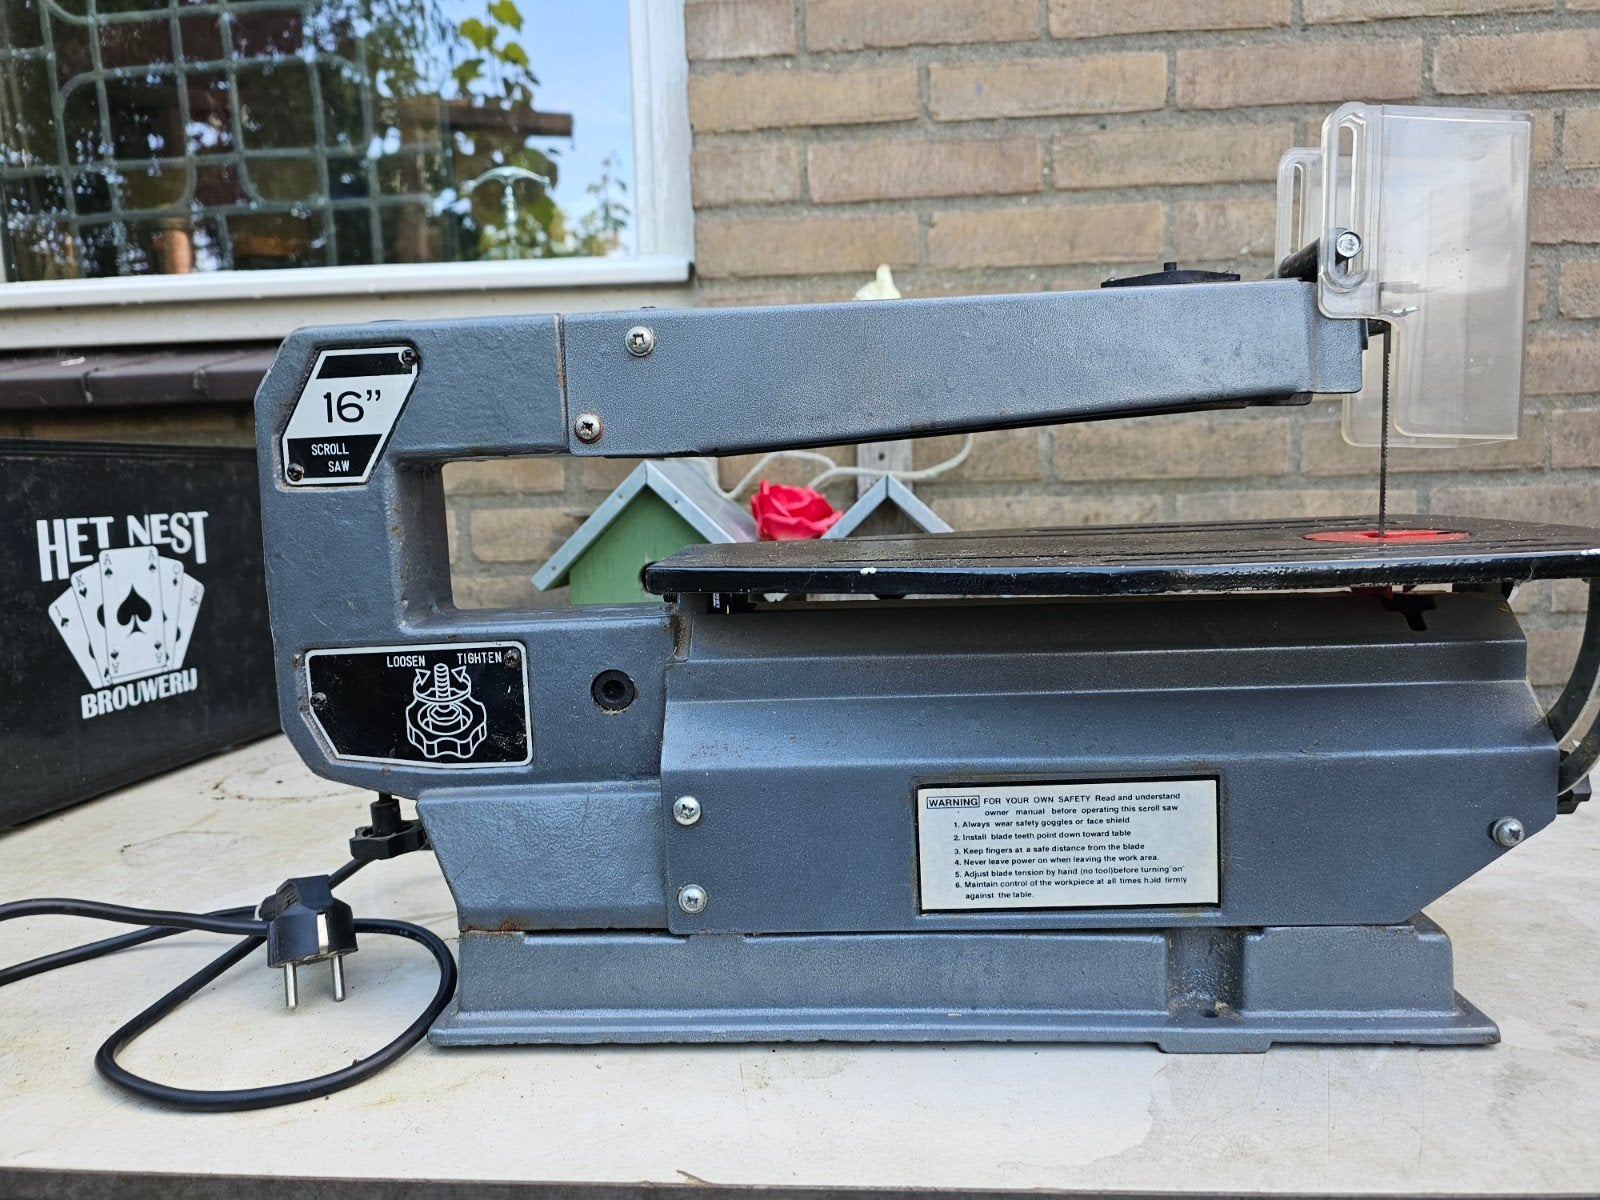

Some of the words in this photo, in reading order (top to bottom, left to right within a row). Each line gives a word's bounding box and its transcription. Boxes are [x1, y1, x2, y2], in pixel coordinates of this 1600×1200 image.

[311, 443, 350, 456] SCROLL
[328, 460, 350, 473] SAW
[36, 516, 115, 582] HET
[126, 511, 209, 564] NEST
[386, 655, 426, 668] LOOSEN
[456, 651, 503, 665] TIGHTEN
[928, 797, 978, 807] WARNING
[983, 797, 1001, 805] FOR
[1005, 796, 1029, 804] YOUR
[1033, 796, 1054, 804] OWN
[1058, 795, 1091, 803] SAFETY
[1095, 794, 1116, 802] Read
[1135, 793, 1181, 801] understand
[984, 809, 1010, 817] owner
[1015, 808, 1045, 816] manual
[1051, 807, 1077, 815] before
[1081, 805, 1119, 814] operating
[1138, 804, 1160, 812] scroll
[962, 821, 991, 829] Always
[1015, 819, 1039, 829] safety
[1041, 818, 1073, 828] goggles
[1105, 816, 1130, 824] shield
[953, 834, 961, 842] 2.
[962, 833, 987, 841] Install
[990, 832, 1013, 840] blade
[1014, 832, 1035, 840] teeth
[1036, 832, 1057, 840] point
[1058, 830, 1081, 838] down
[1082, 830, 1110, 838] toward
[1111, 829, 1132, 837] table
[963, 847, 984, 856] Keep
[985, 846, 1013, 855] fingers
[1033, 845, 1050, 853] safe
[1051, 844, 1086, 852] distance
[1087, 843, 1106, 852] from
[1108, 843, 1121, 851] the
[1122, 842, 1145, 850] blade
[963, 858, 987, 866] Never
[988, 858, 1010, 866] leave
[1011, 857, 1036, 866] power
[1050, 856, 1071, 864] when
[1073, 855, 1102, 864] leaving
[1103, 854, 1117, 862] the
[1118, 854, 1138, 862] work
[963, 870, 990, 879] Adjust
[991, 869, 1013, 877] blade
[1014, 868, 1044, 876] tension
[1045, 868, 1056, 877] by
[1057, 867, 1078, 876] hand
[1080, 867, 1094, 876] (no
[964, 880, 998, 888] Maintain
[1000, 880, 1028, 888] control
[1029, 879, 1039, 887] of
[1039, 879, 1053, 887] the
[1054, 877, 1095, 887] workpiece
[1096, 877, 1105, 885] at
[1106, 877, 1117, 885] all
[1119, 876, 1142, 884] times
[1164, 876, 1188, 885] firmly
[965, 892, 995, 901] against
[998, 891, 1011, 899] the
[1012, 890, 1035, 899] table.
